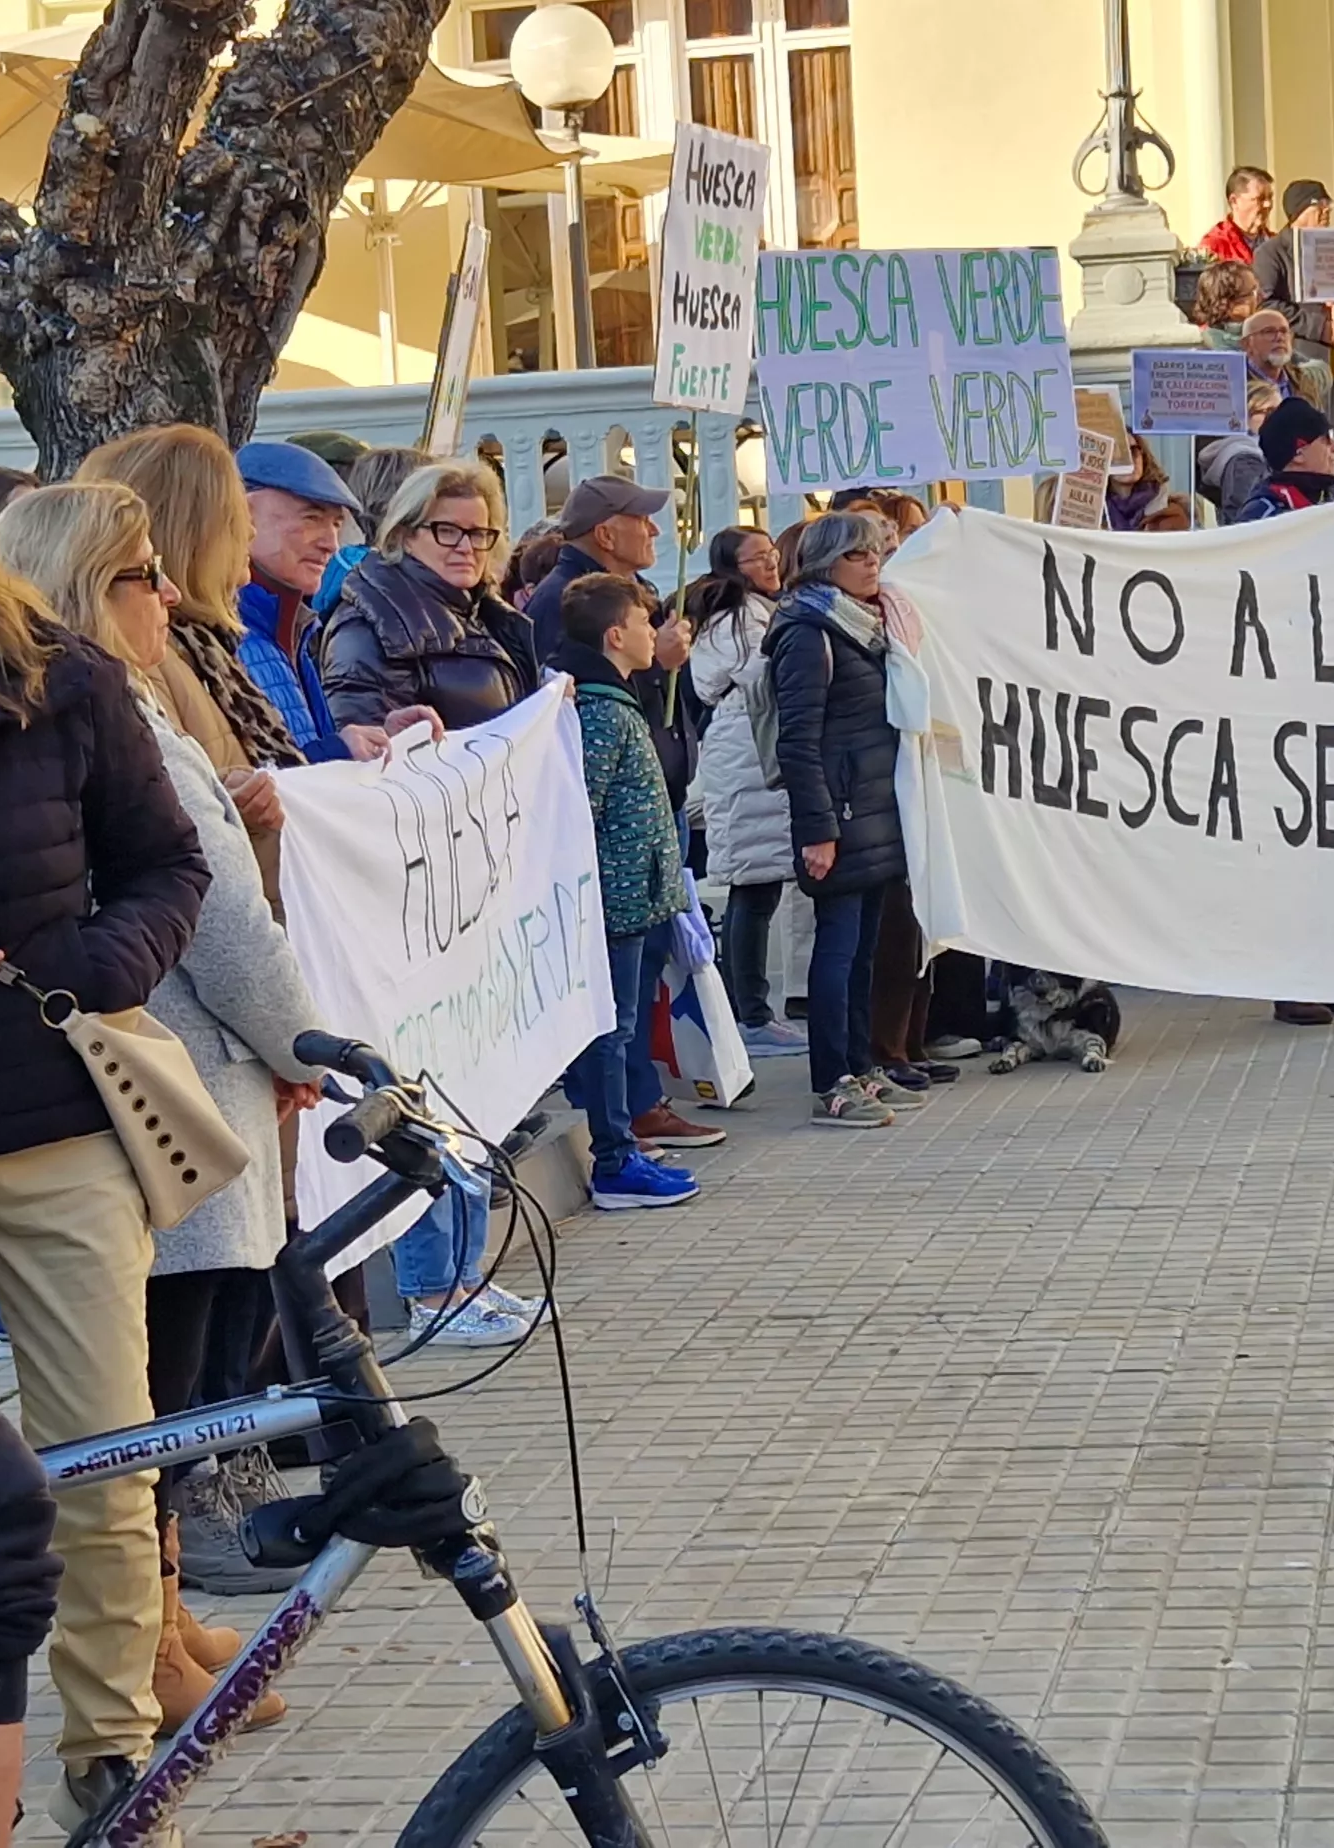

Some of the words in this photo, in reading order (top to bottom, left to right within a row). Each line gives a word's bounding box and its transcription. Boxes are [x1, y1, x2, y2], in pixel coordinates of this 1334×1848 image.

[685, 138, 756, 211] HUESCA
[673, 270, 741, 332] HUESCA
[755, 252, 919, 356] HUESCA
[935, 250, 1066, 346] VERDE
[669, 343, 731, 400] FUERTE
[761, 380, 917, 485] VERDE,
[929, 369, 1066, 470] VERDE
[1042, 540, 1185, 666] NO
[1229, 570, 1277, 680] A
[977, 677, 1244, 842] HUESCA
